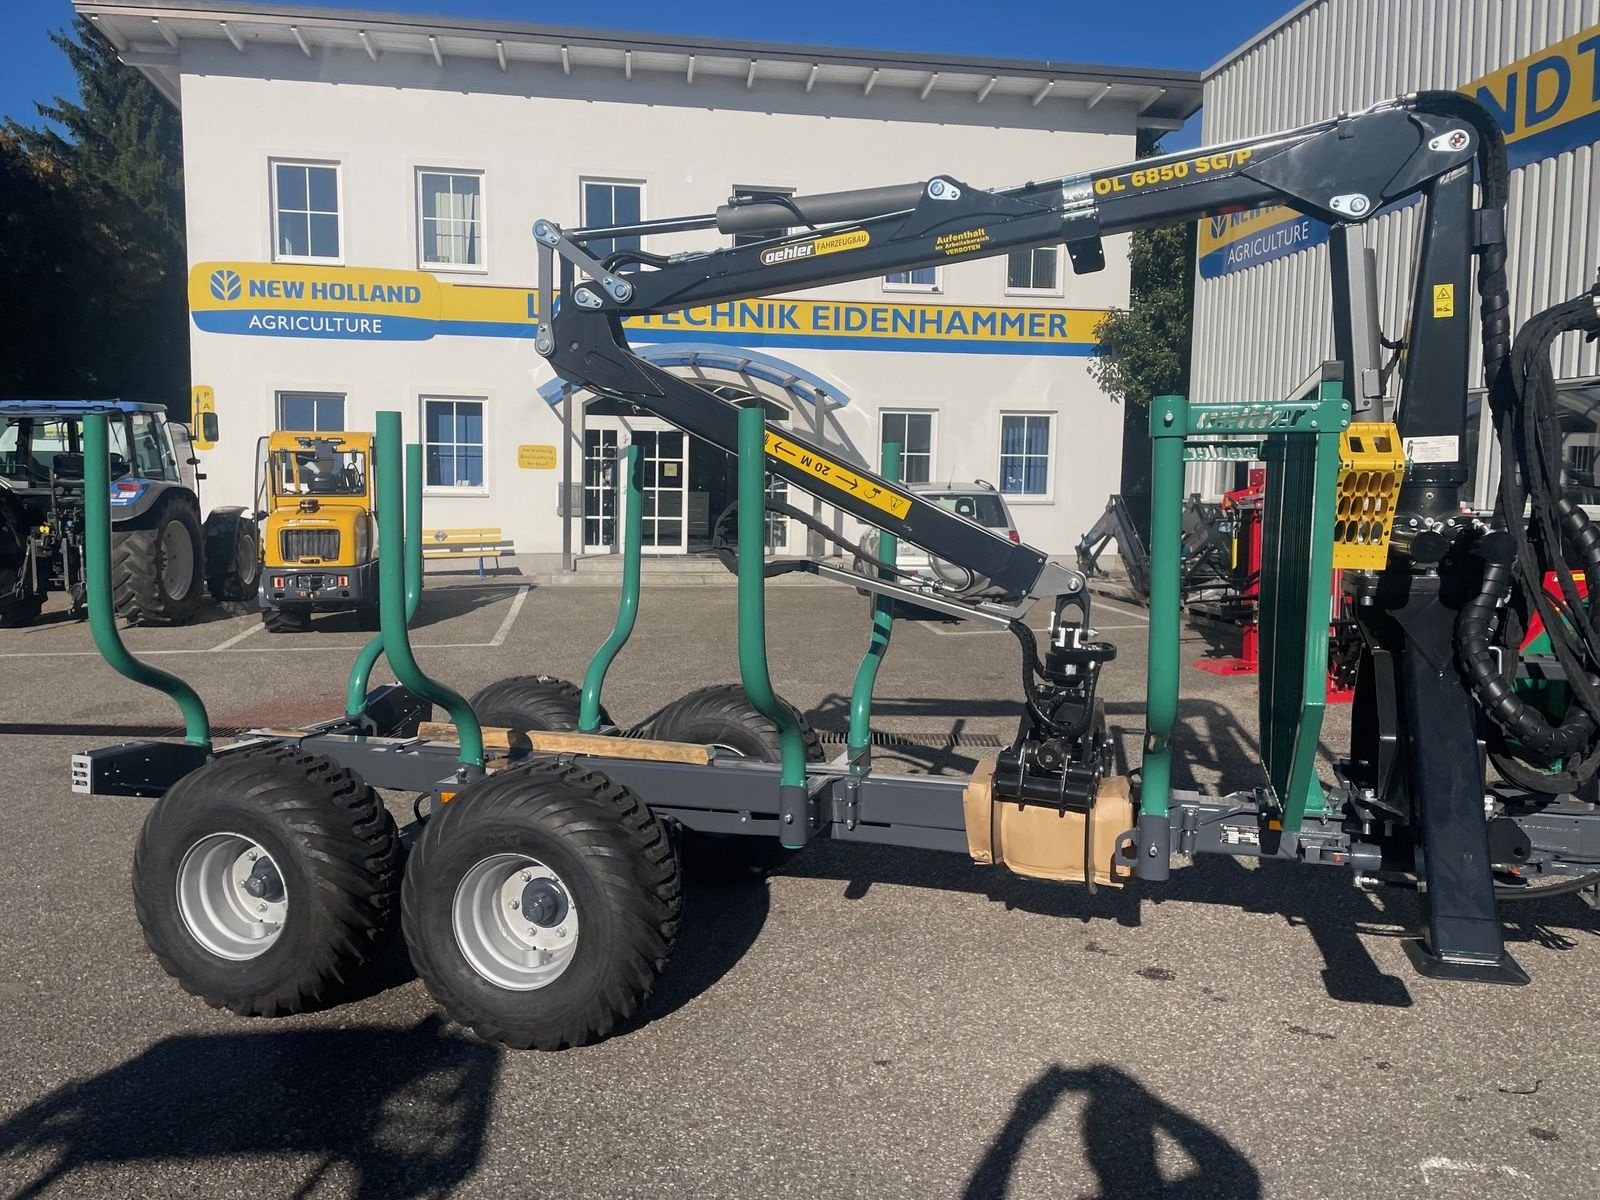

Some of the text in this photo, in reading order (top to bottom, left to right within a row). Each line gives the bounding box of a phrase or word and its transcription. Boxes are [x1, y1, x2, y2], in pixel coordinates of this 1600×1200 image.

[1094, 148, 1252, 196] OL 6850 SG/P
[936, 227, 986, 245] Aufenthalt
[944, 236, 990, 249] Arbeitsbereich
[1227, 220, 1310, 265] AGRICULTURE
[765, 233, 868, 263] oehler FAHRZEUGBAU
[944, 243, 981, 256] VERBOTEN
[248, 279, 421, 304] NEW HOLLAND
[248, 314, 383, 334] AGRICULTURE
[812, 305, 1068, 338] EIDENHAMMER
[800, 455, 831, 476] 20 M
